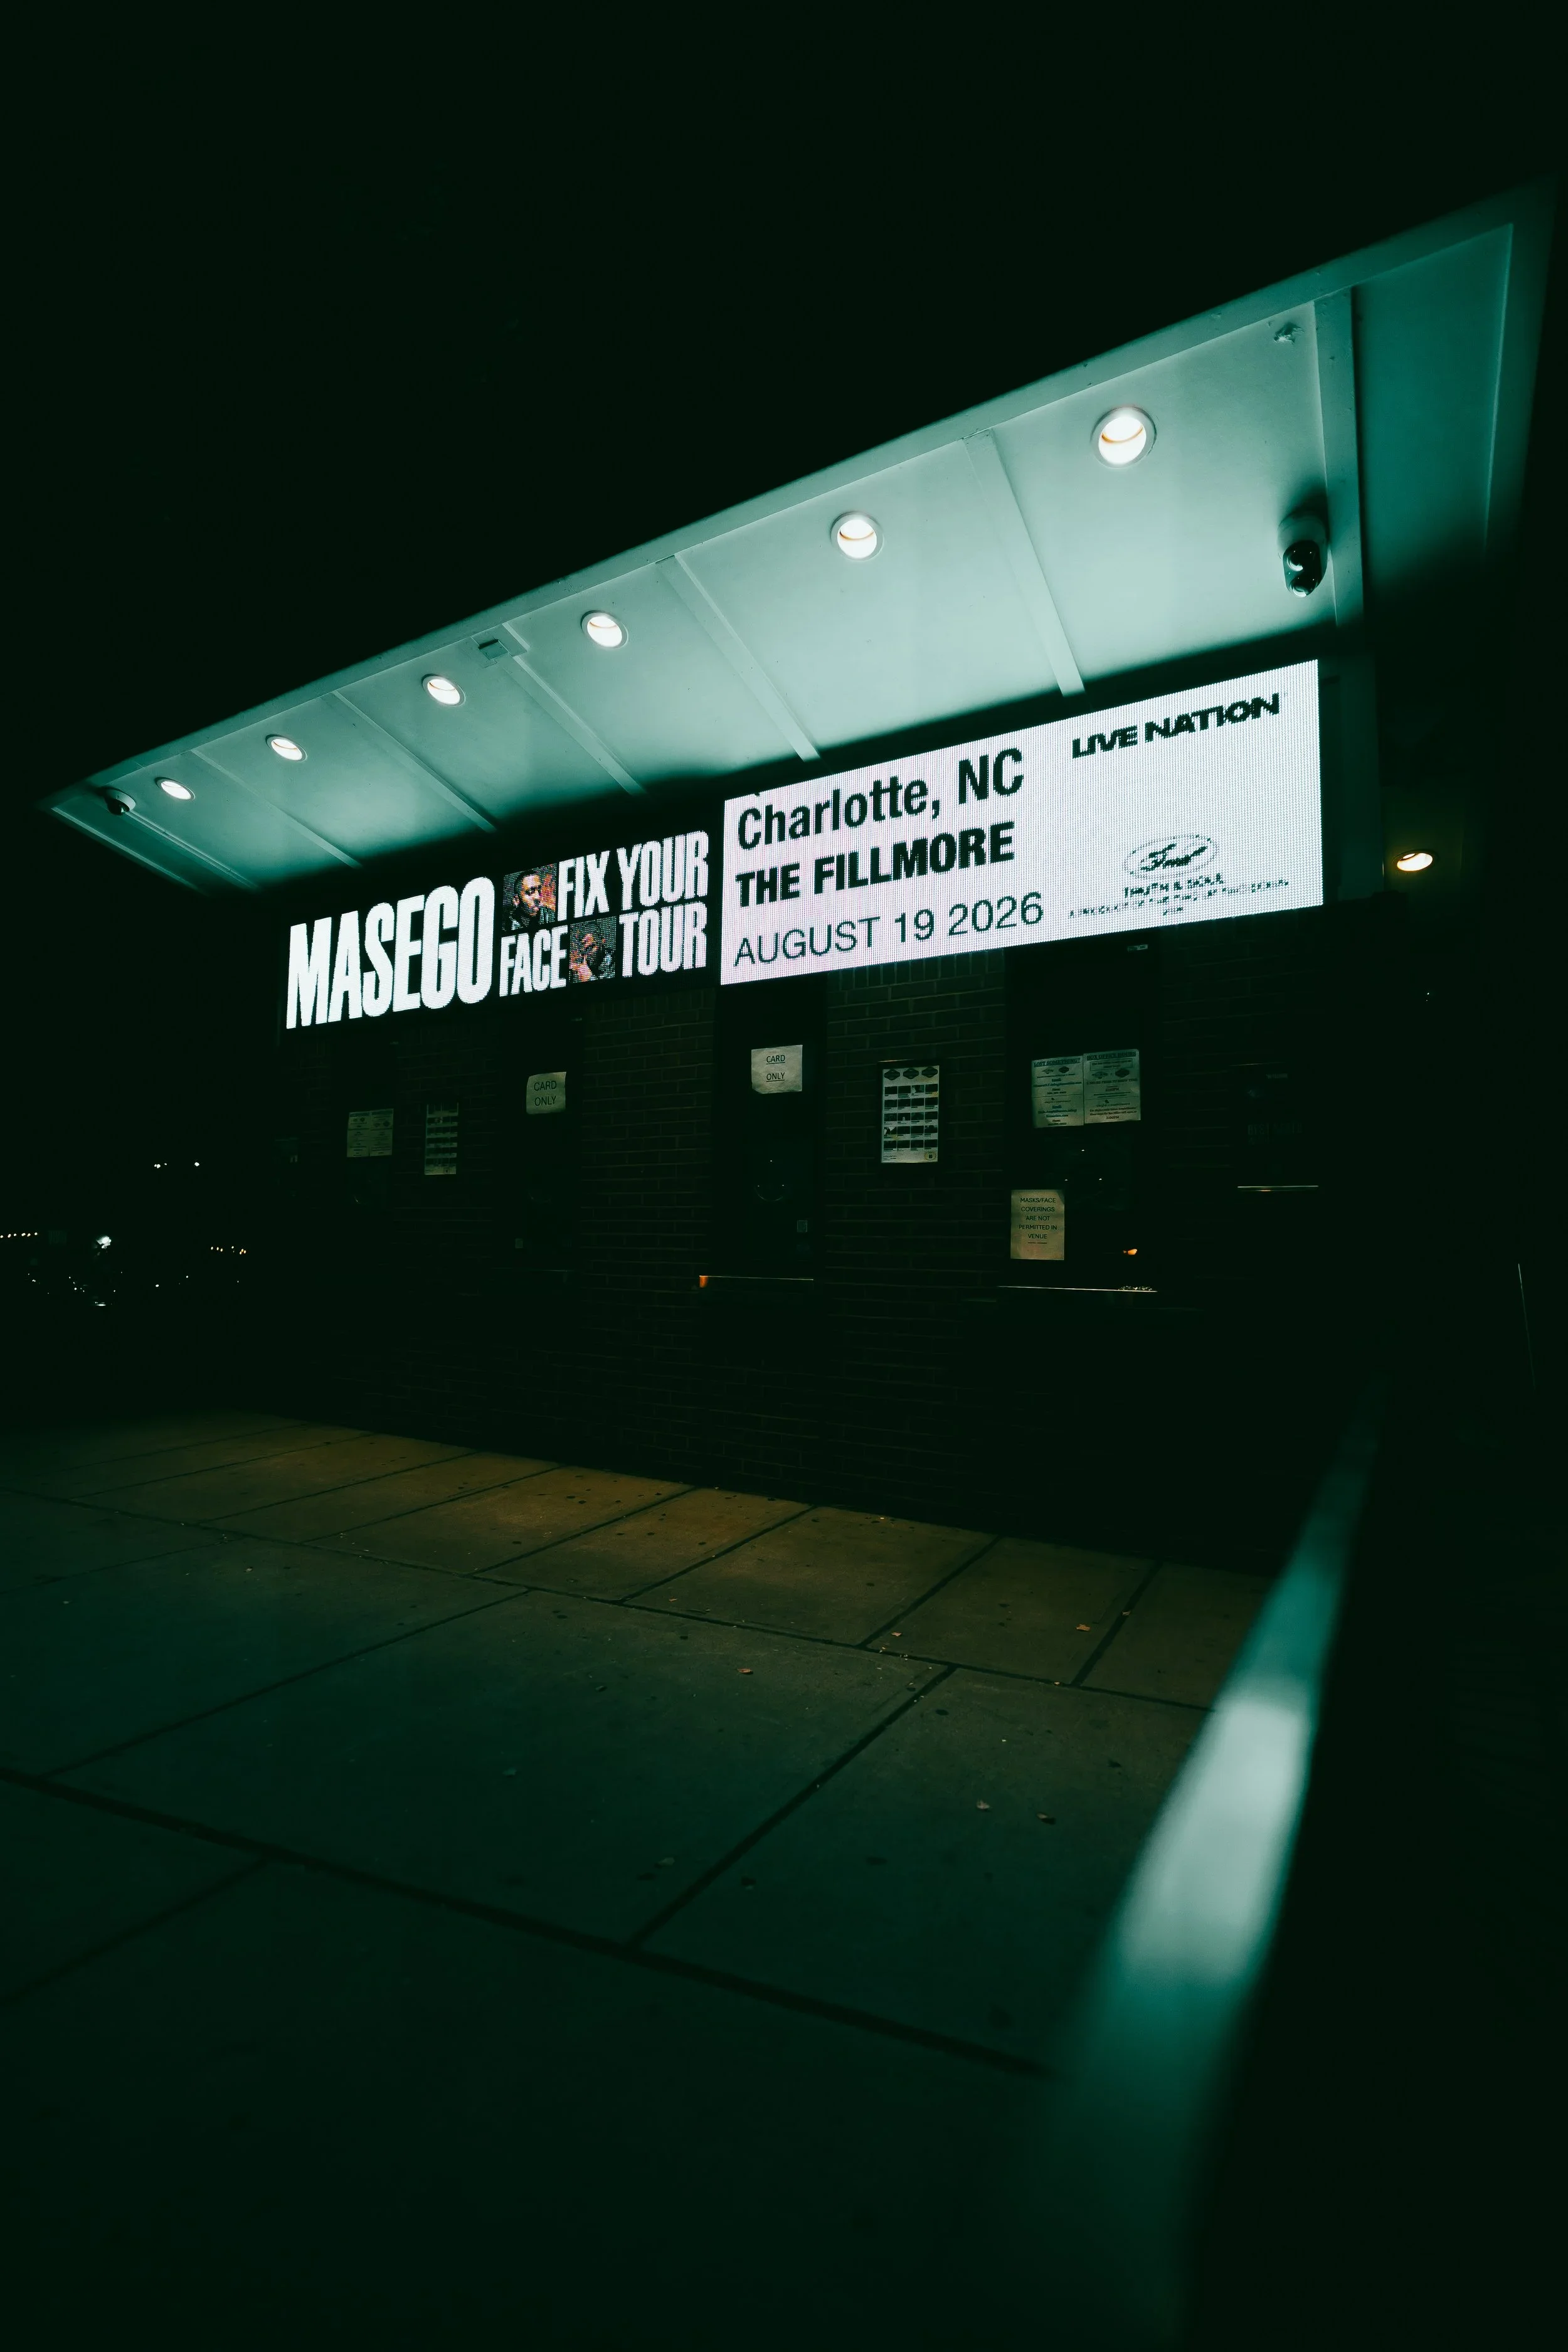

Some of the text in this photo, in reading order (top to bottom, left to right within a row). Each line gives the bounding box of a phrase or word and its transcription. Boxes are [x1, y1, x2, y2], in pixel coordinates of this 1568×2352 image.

[1072, 692, 1279, 759] LIVE NATION
[738, 748, 1024, 850] Charlotte, NC
[557, 830, 710, 921] FIX YOUR
[735, 820, 1015, 908] THE FILLMORE
[286, 876, 495, 1029] MASEGO
[499, 901, 708, 997] FACE TOUR
[733, 891, 1044, 967] AUGUST 19 2026
[534, 1080, 557, 1091] CARD
[766, 1054, 786, 1064] CARD
[766, 1072, 785, 1081] ONLY
[534, 1095, 557, 1106] ONLY
